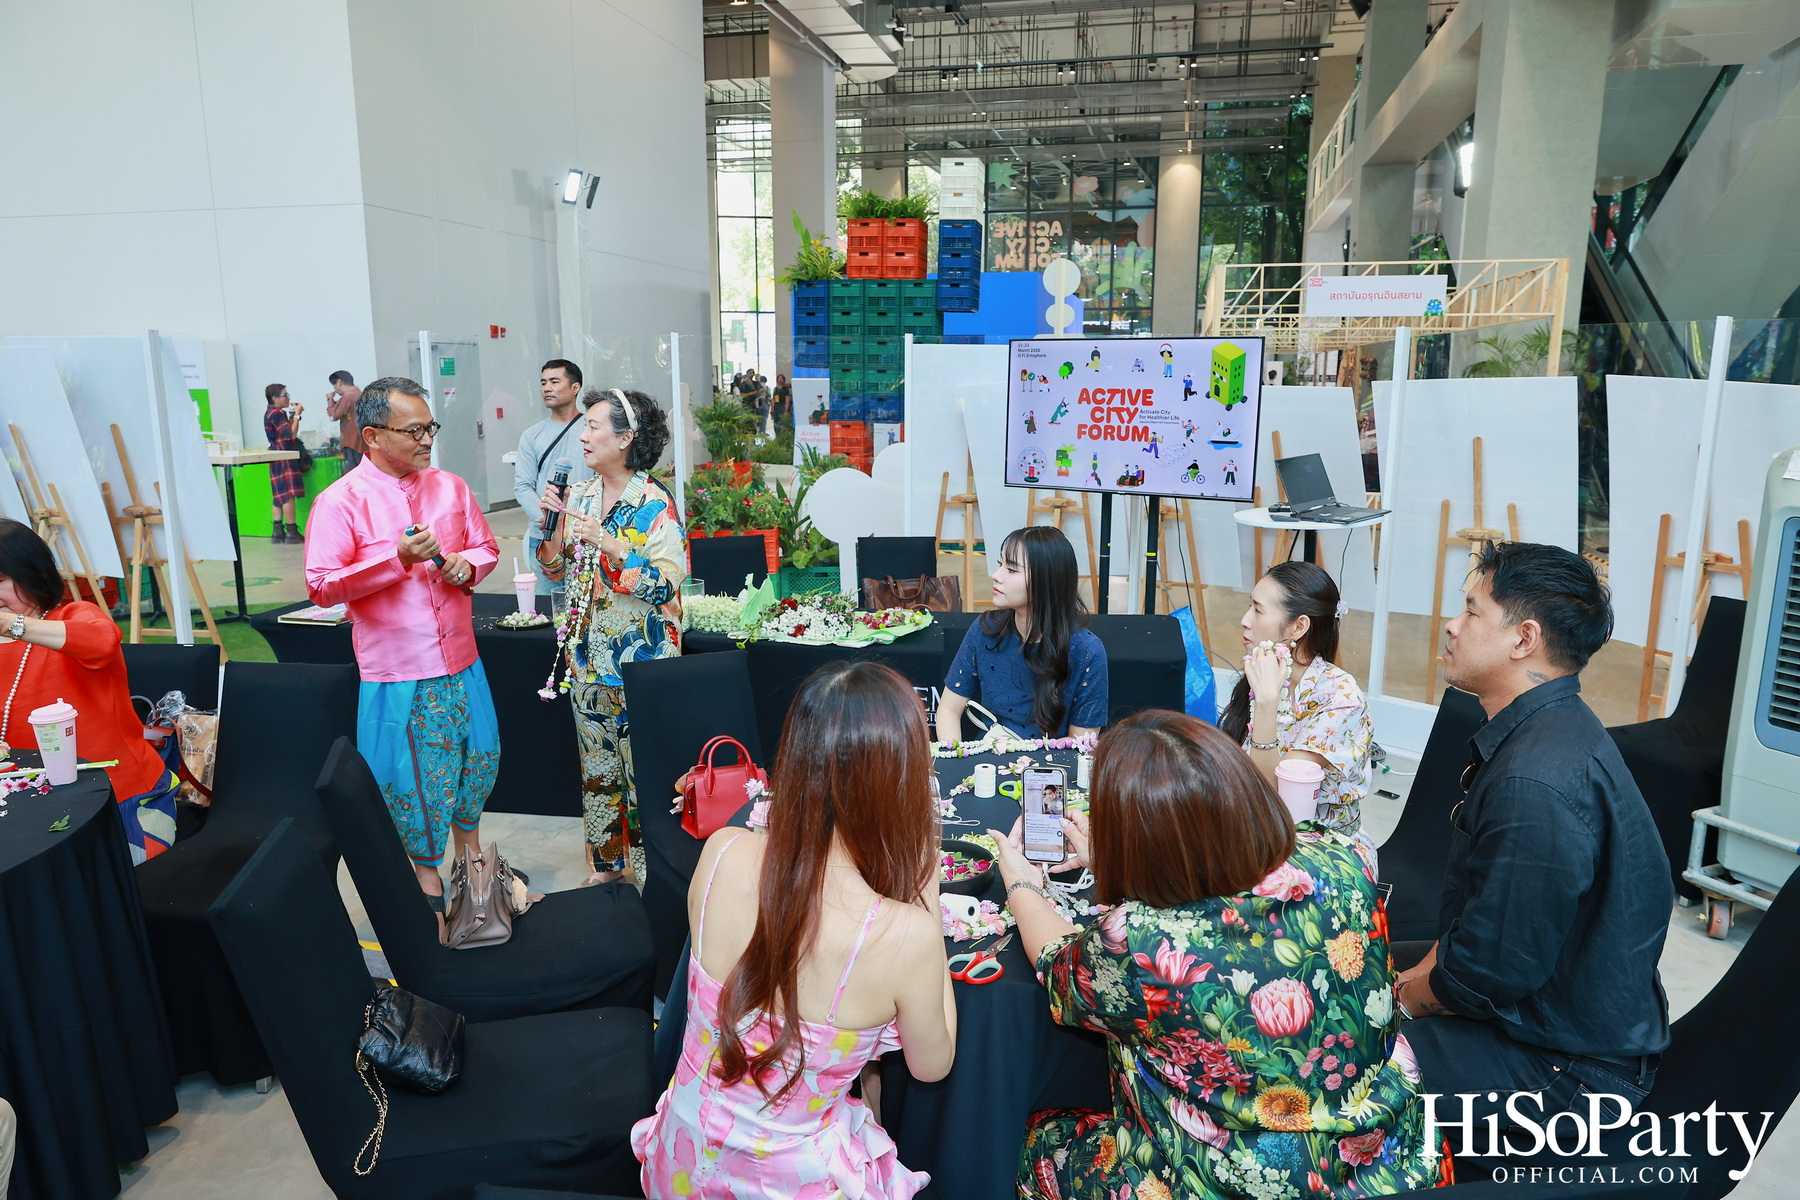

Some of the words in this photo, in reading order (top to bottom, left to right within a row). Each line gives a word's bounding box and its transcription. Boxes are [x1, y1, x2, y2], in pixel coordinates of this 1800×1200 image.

[1329, 290, 1423, 302] สถาบันอรุณอินสยาม
[1077, 388, 1154, 406] ACTIVE
[1090, 406, 1139, 424] CITY
[1077, 424, 1149, 442] FORUM
